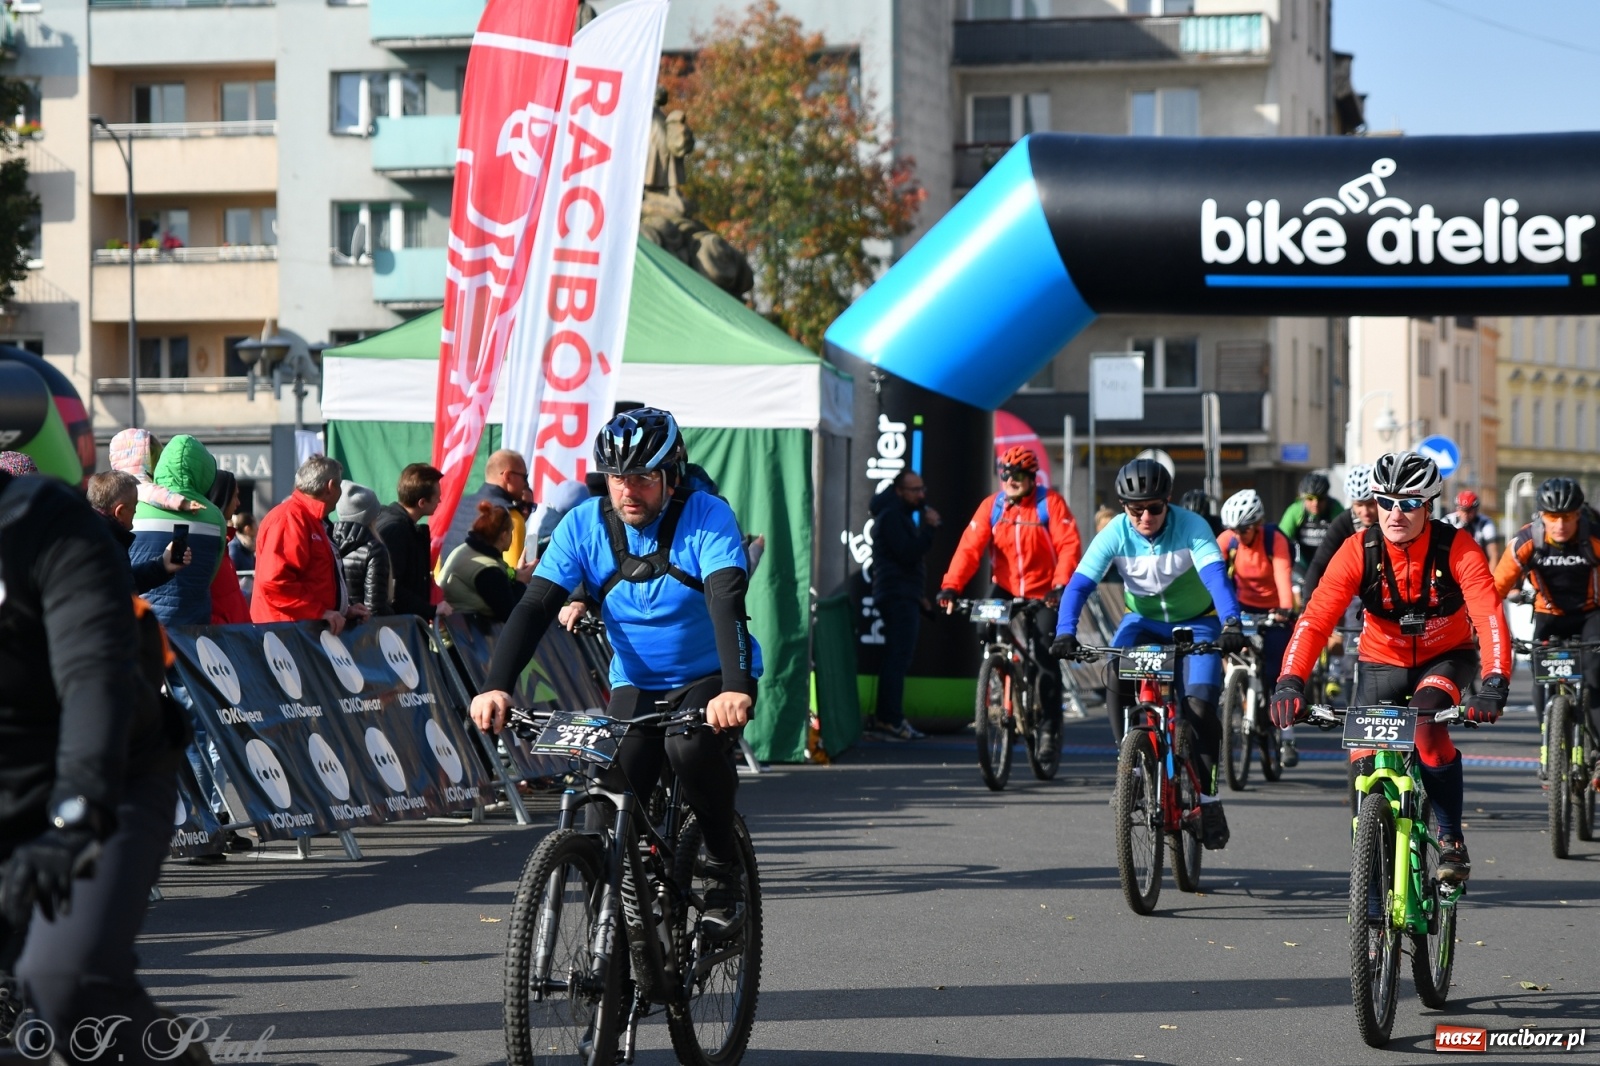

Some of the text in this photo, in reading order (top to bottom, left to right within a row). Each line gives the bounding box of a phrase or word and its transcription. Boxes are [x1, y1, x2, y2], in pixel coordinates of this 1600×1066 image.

[1201, 198, 1597, 265] bike atelier
[533, 65, 623, 504] RACIBÓRZ
[212, 452, 272, 477] ERA
[1541, 659, 1575, 667] OPIEKUN
[1547, 665, 1573, 677] 148
[279, 702, 323, 719] KOKOwear
[338, 696, 382, 714] KOKOwear
[216, 706, 264, 725] KOKOwear
[1355, 717, 1406, 726] OPIEKUN
[555, 732, 598, 749] 211
[1363, 725, 1399, 741] 125
